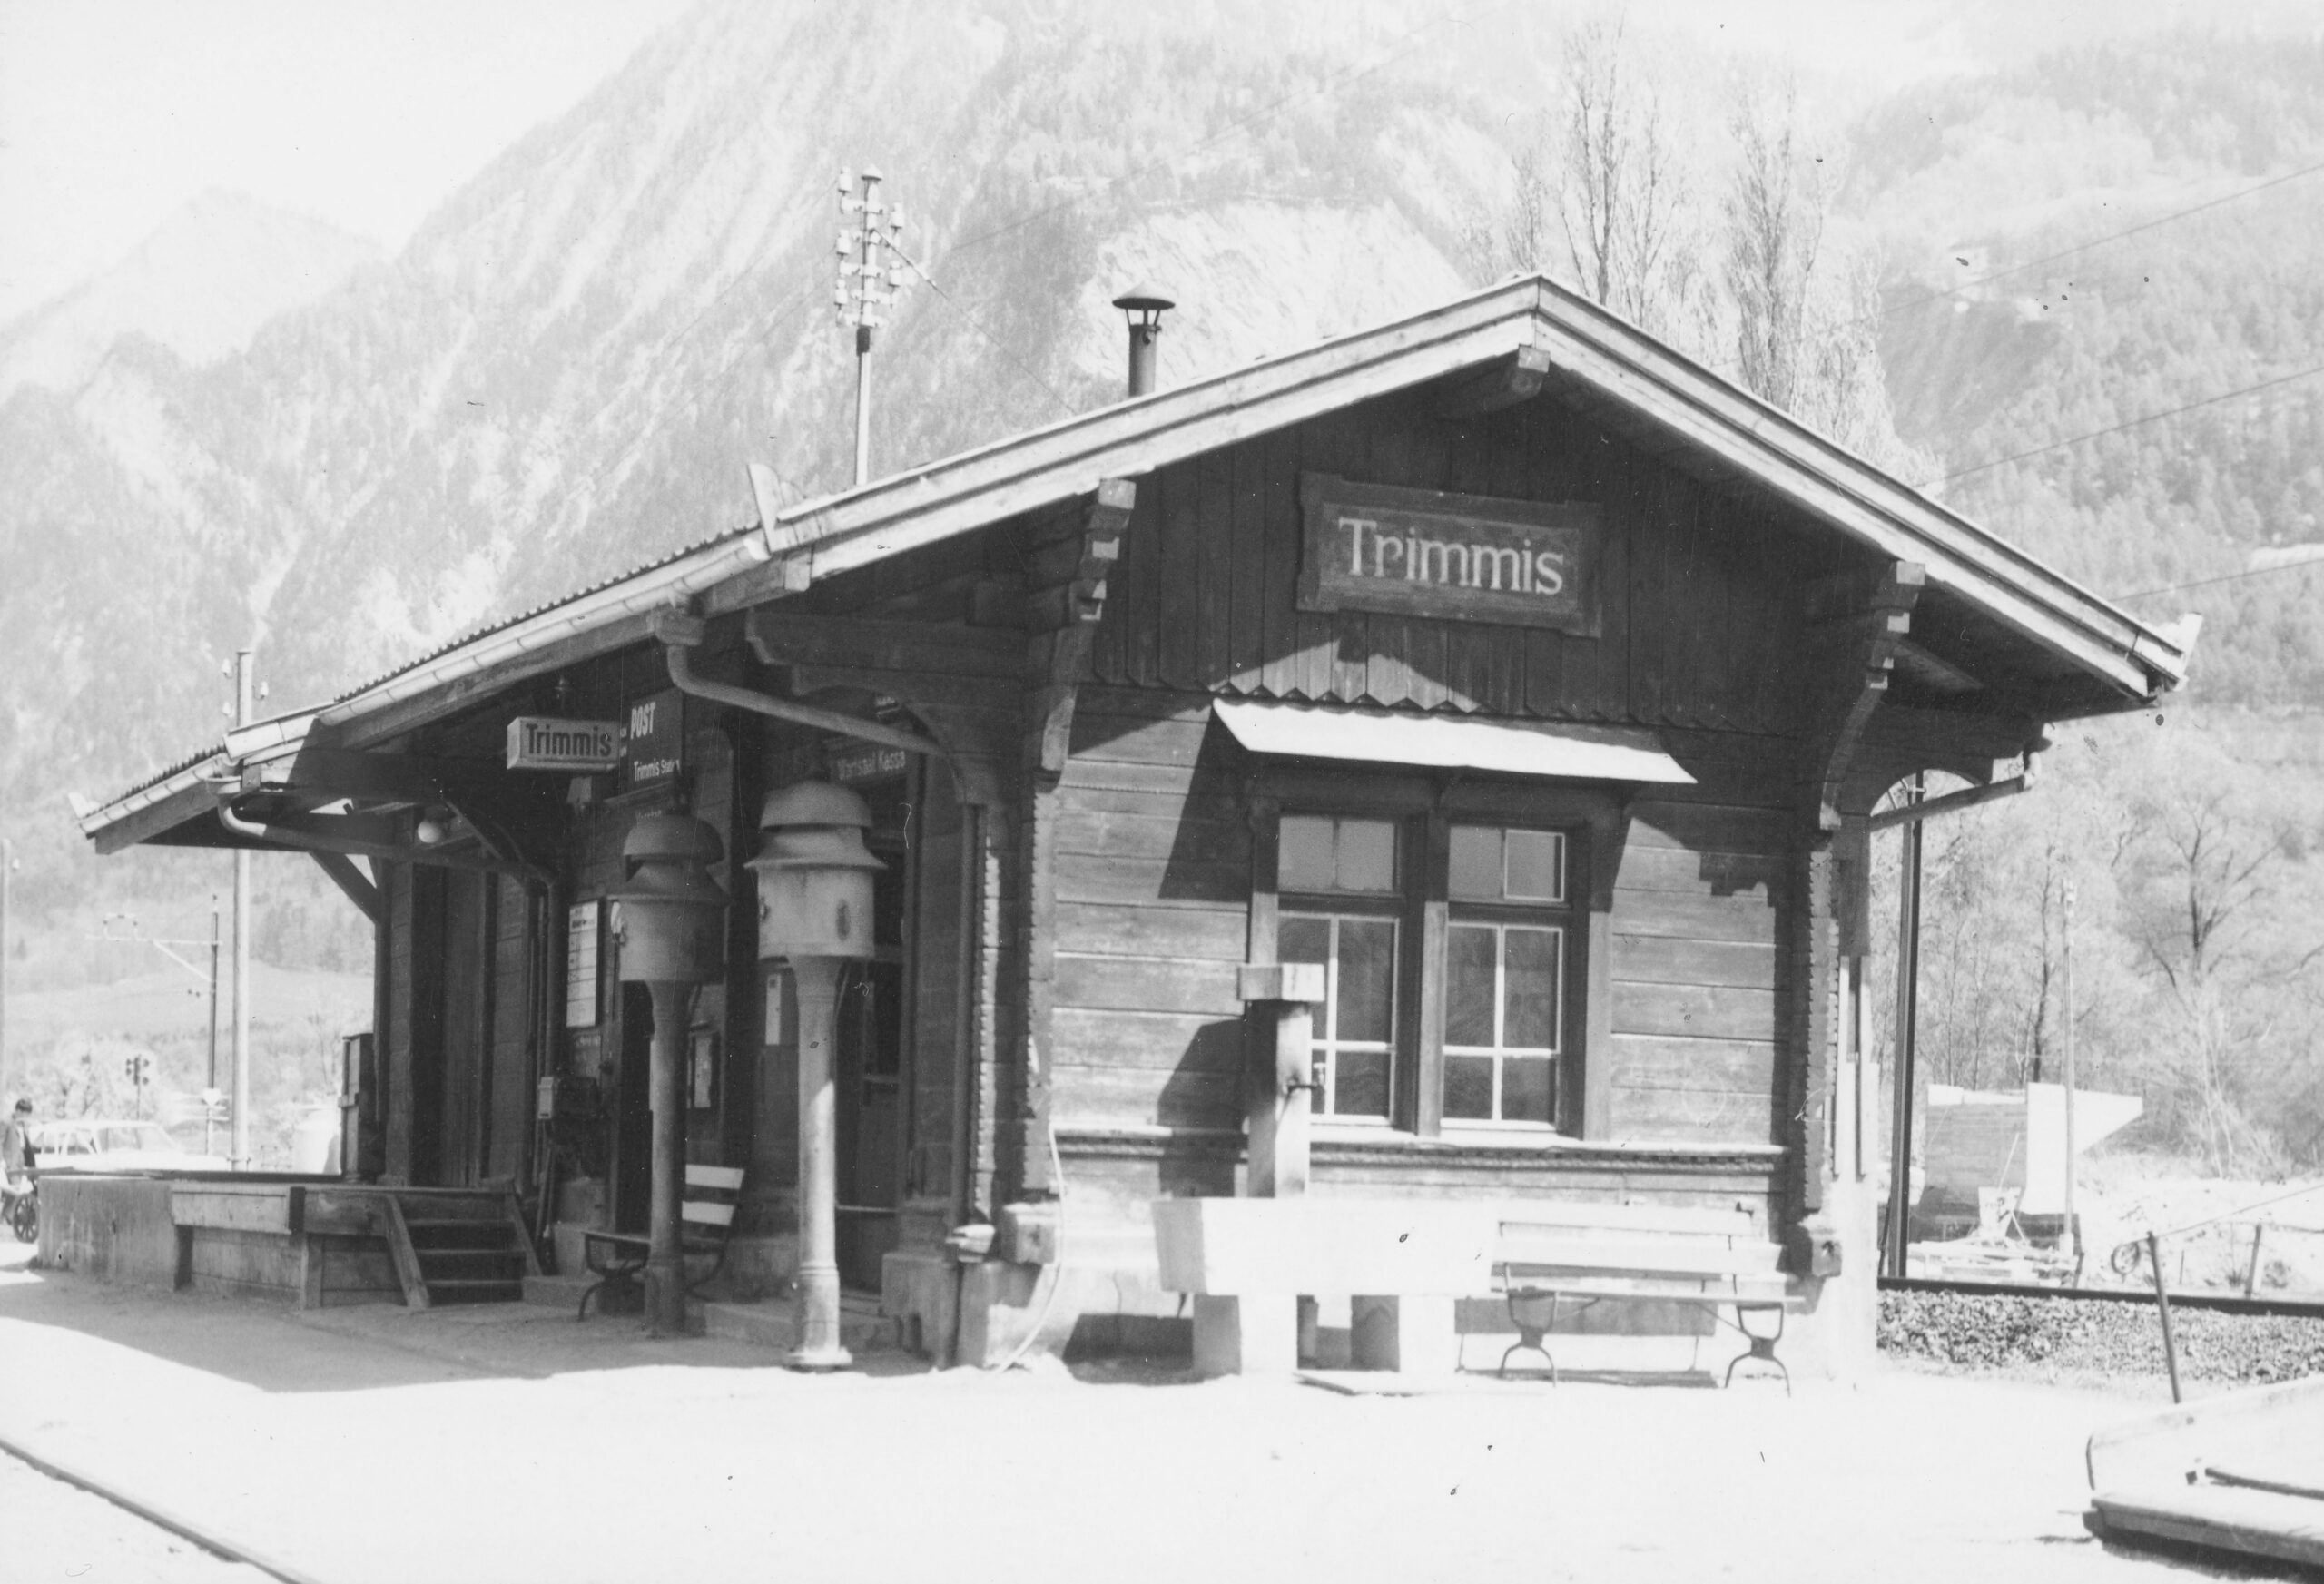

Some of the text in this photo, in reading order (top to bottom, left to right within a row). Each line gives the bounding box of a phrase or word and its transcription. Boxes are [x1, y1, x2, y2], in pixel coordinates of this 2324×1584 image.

[1338, 517, 1563, 595] Trimmis
[630, 701, 656, 740] POST
[526, 723, 612, 757] Trimmis
[634, 757, 660, 782] Trimmis
